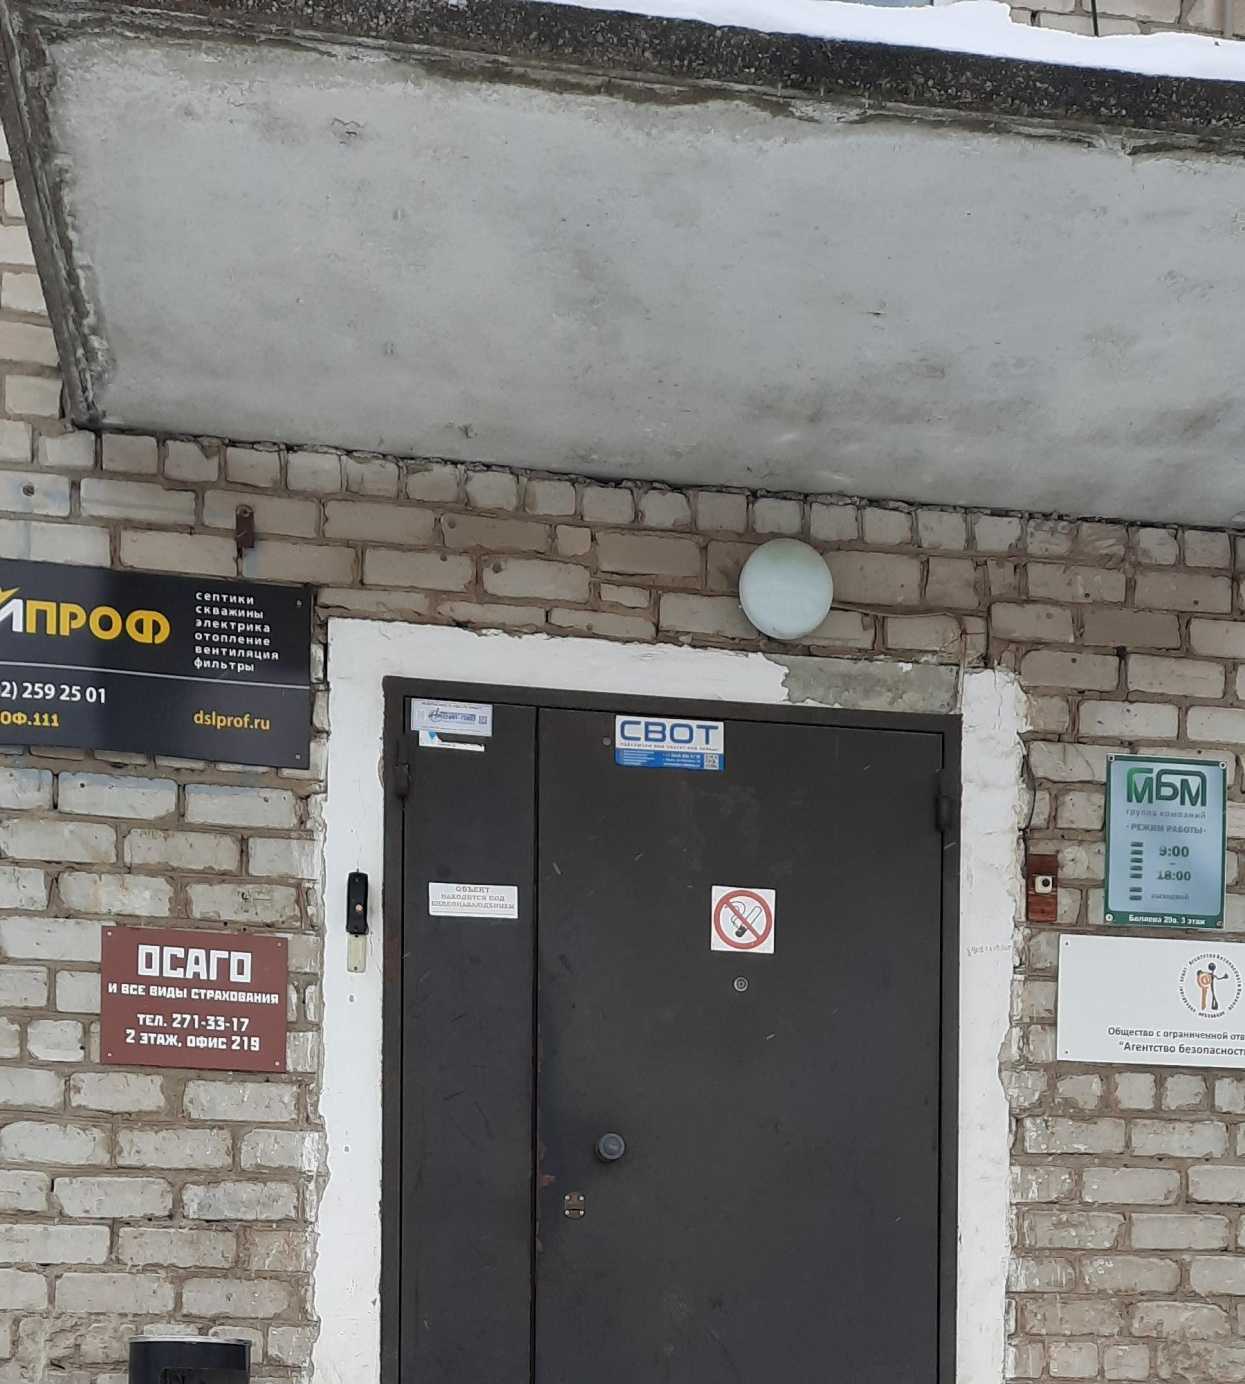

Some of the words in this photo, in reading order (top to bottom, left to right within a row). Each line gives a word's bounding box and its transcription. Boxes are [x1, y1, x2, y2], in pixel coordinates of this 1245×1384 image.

[195, 591, 254, 605] септики
[195, 605, 264, 619] скважины
[195, 618, 271, 633] электрика
[194, 632, 271, 646] отопление
[194, 645, 279, 661] вентиляция
[193, 656, 255, 673] фильтры
[22, 682, 56, 699] 259
[59, 685, 81, 701] 25
[85, 687, 106, 704] 01
[193, 710, 270, 730] dslprof.ru
[1159, 846, 1190, 857] 9:00
[1157, 870, 1192, 881] 18:00
[138, 944, 252, 983] ОСАГО
[108, 983, 117, 993] И
[121, 984, 146, 995] ВСЕ
[149, 985, 187, 998] ВИДЫ
[191, 989, 279, 1004] СТРАХОВАНИЯ
[137, 1014, 167, 1027] ТЕЛ.
[172, 1014, 249, 1031] 271-33-17
[126, 1030, 135, 1043] 2
[139, 1033, 182, 1047] ЭТАЖ,
[187, 1036, 227, 1048] ОФИС
[231, 1036, 260, 1051] 219
[1108, 1027, 1154, 1037] Общество
[1163, 1030, 1229, 1040] ограниченной
[1178, 1044, 1245, 1056] безопасност
